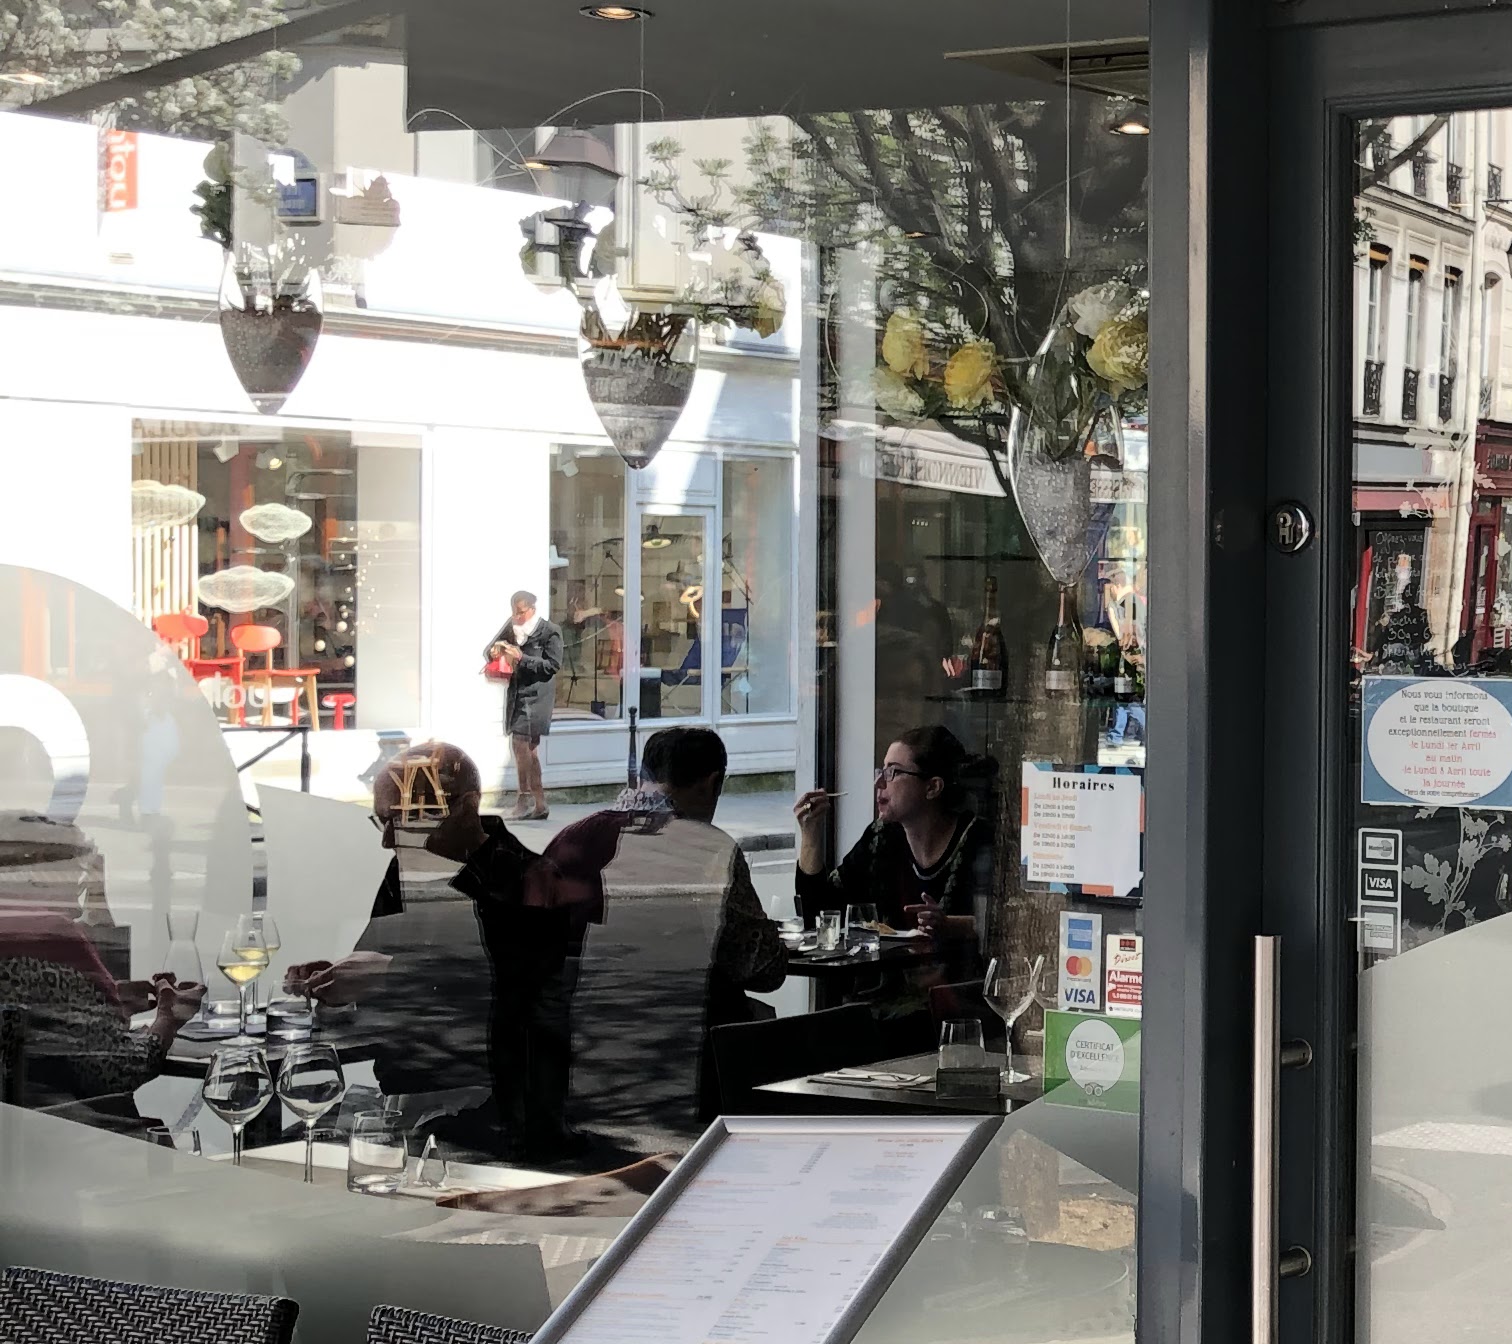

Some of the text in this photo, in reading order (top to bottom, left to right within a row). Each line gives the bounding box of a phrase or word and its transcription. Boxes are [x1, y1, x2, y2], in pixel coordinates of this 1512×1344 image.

[1401, 689, 1422, 699] Nous
[1052, 776, 1115, 792] Horaires
[1369, 877, 1393, 889] VISA
[1065, 988, 1096, 1004] VISA
[1075, 1039, 1114, 1051] CERTIFICAT
